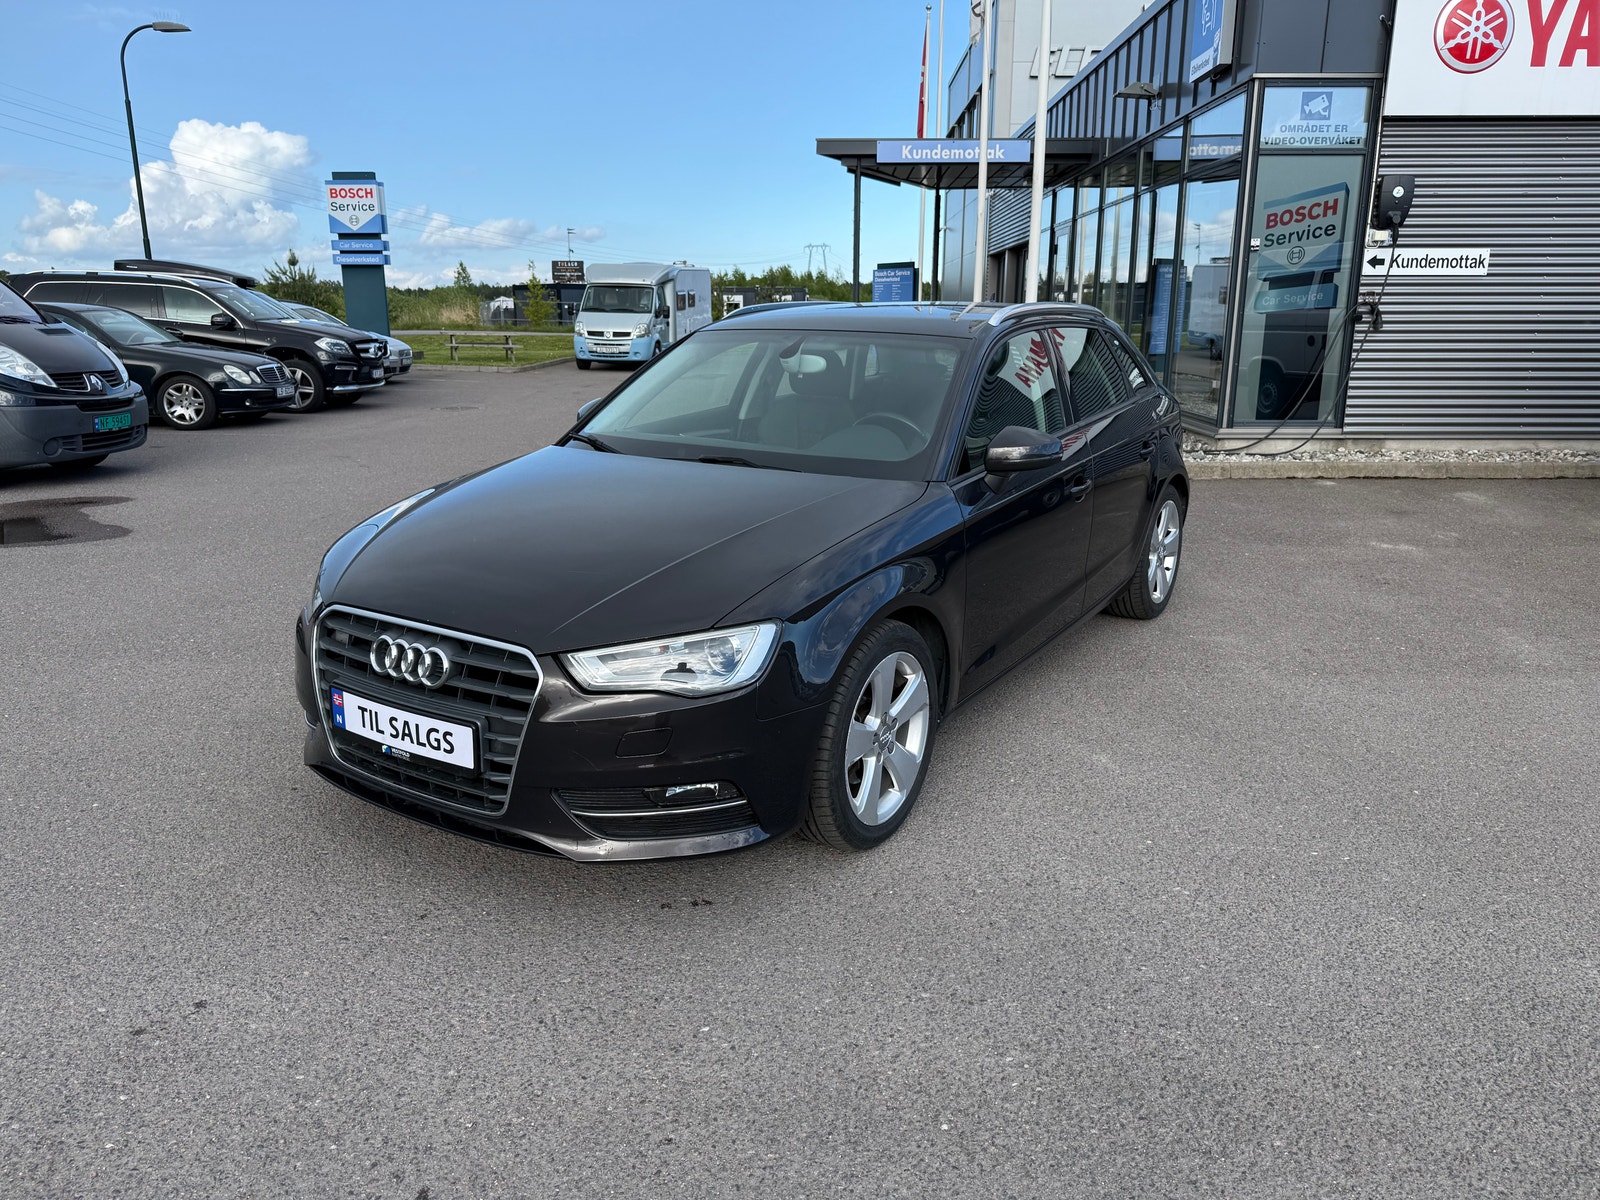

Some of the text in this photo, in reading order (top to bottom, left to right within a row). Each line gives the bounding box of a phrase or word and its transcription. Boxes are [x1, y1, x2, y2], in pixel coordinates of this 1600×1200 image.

[1280, 122, 1348, 133] OMRÅDET ER
[1263, 134, 1362, 145] VIDEO-OVERVÅKET
[902, 144, 1005, 159] Kundemotak
[330, 188, 373, 198] BOSCH
[330, 201, 375, 212] Service
[1265, 198, 1339, 229] BOSCH
[1264, 224, 1336, 247] Service
[1390, 254, 1487, 269] Kundemottak
[1262, 291, 1323, 306] Car Service
[336, 714, 342, 724] N
[358, 705, 455, 754] TIL SALGS
